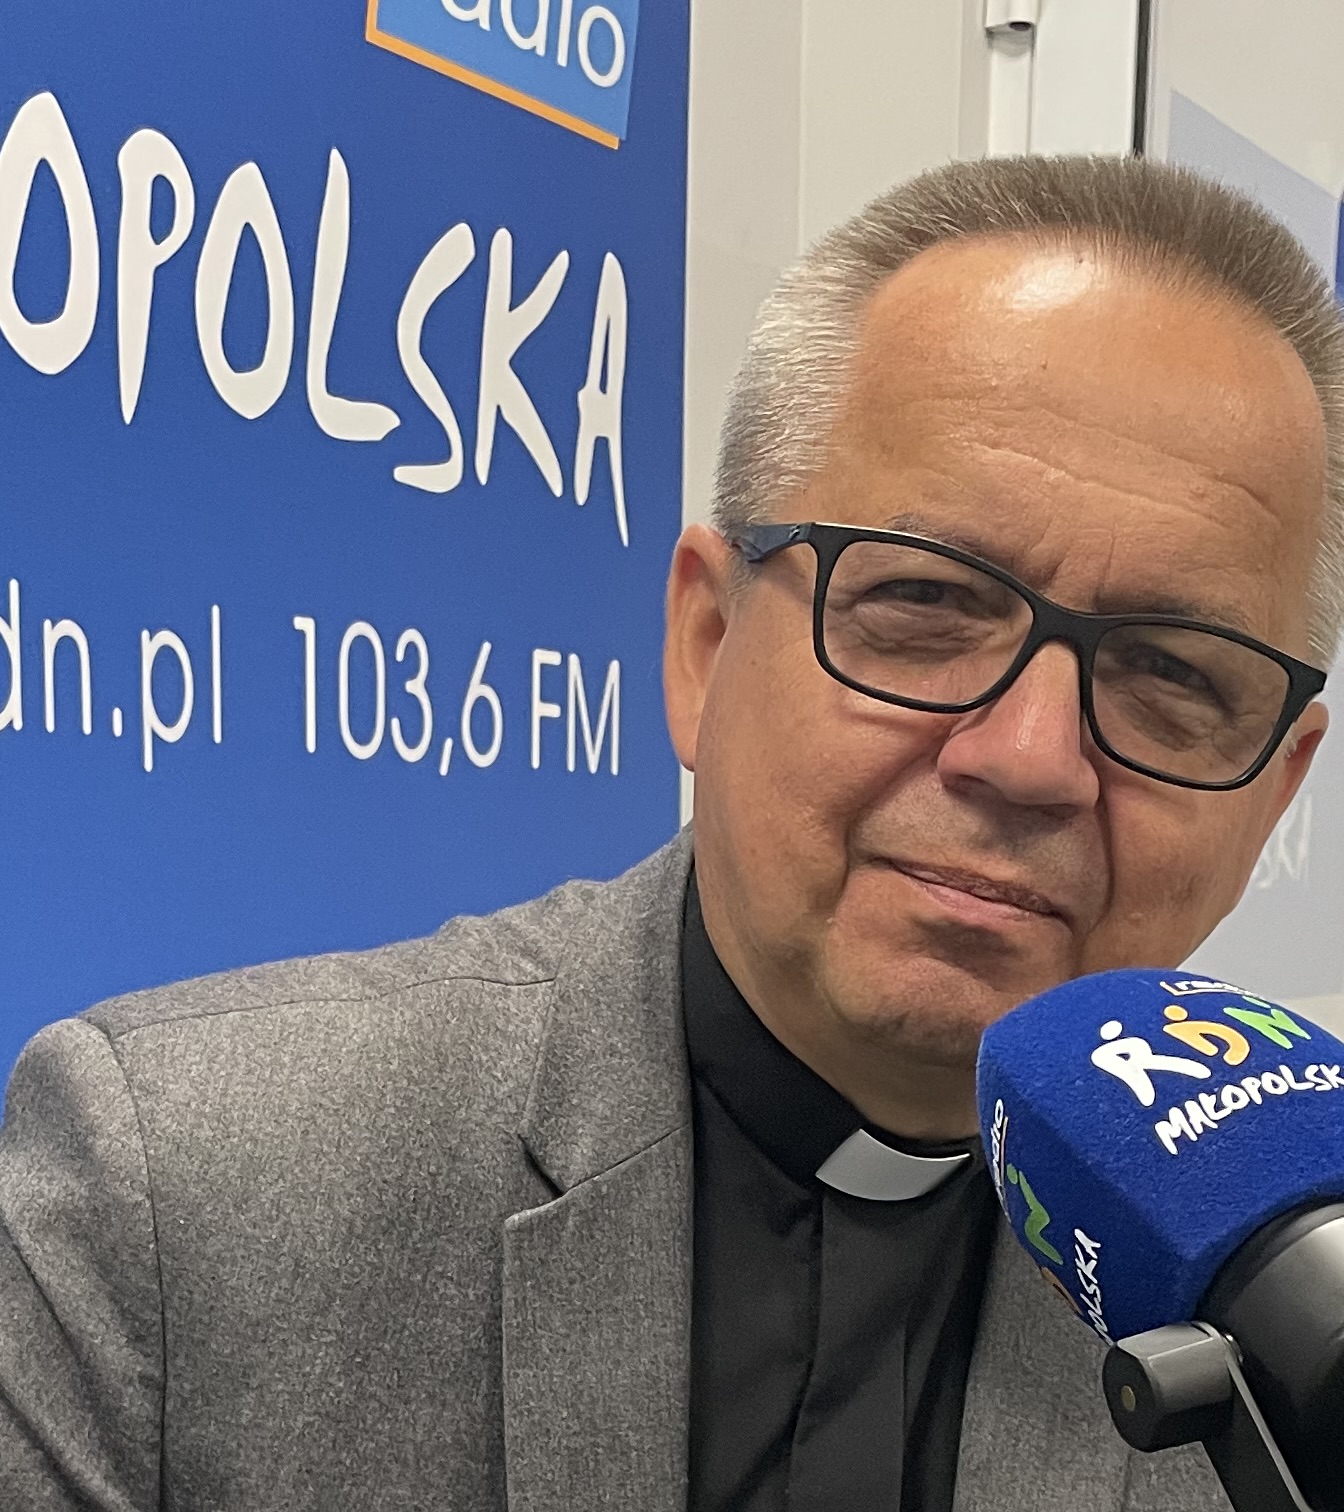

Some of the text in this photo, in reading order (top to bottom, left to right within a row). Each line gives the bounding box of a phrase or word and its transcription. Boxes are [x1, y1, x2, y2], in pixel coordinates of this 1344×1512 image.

[293, 615, 503, 776] 103,6
[531, 649, 621, 775] FM
[1090, 1003, 1312, 1107] RDN
